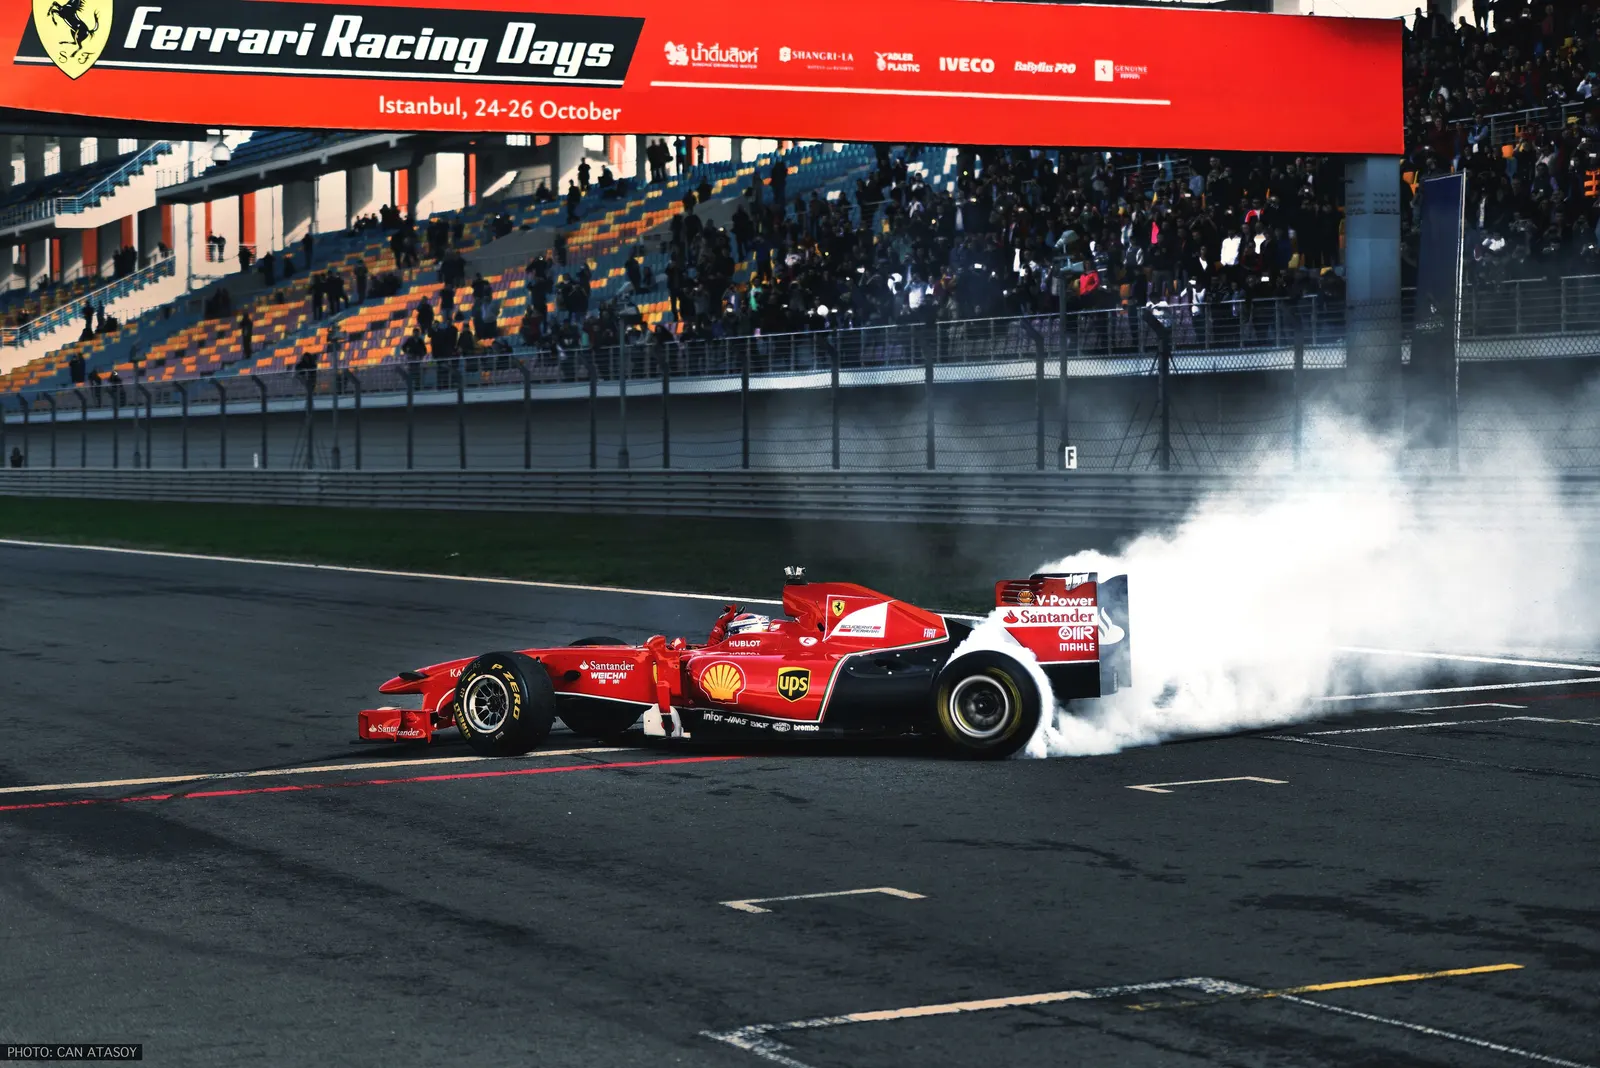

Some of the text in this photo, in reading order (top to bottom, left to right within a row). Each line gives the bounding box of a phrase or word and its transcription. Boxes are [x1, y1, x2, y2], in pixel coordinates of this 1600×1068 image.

[123, 6, 615, 77] Ferrari Racing Days
[792, 51, 854, 62] SHANGRI-LA
[887, 63, 920, 72] PLASTIC
[939, 57, 995, 73] IVECO
[1055, 63, 1076, 74] PRO
[1115, 65, 1147, 73] GENUINE
[378, 95, 621, 121] Istanbul, 24-26 October
[1067, 449, 1075, 467] F
[1036, 594, 1094, 606] V-Power
[1020, 609, 1094, 624] Santander
[923, 627, 936, 639] FIAT
[729, 640, 761, 648] HUBLOT
[1059, 642, 1095, 652] MAHLE
[590, 660, 635, 671] Santander
[450, 667, 465, 678] KA
[590, 672, 627, 680] WEICHAI
[779, 675, 808, 697] ups
[502, 671, 522, 720] ZERO
[703, 711, 723, 721] infor
[793, 724, 820, 732] brembo
